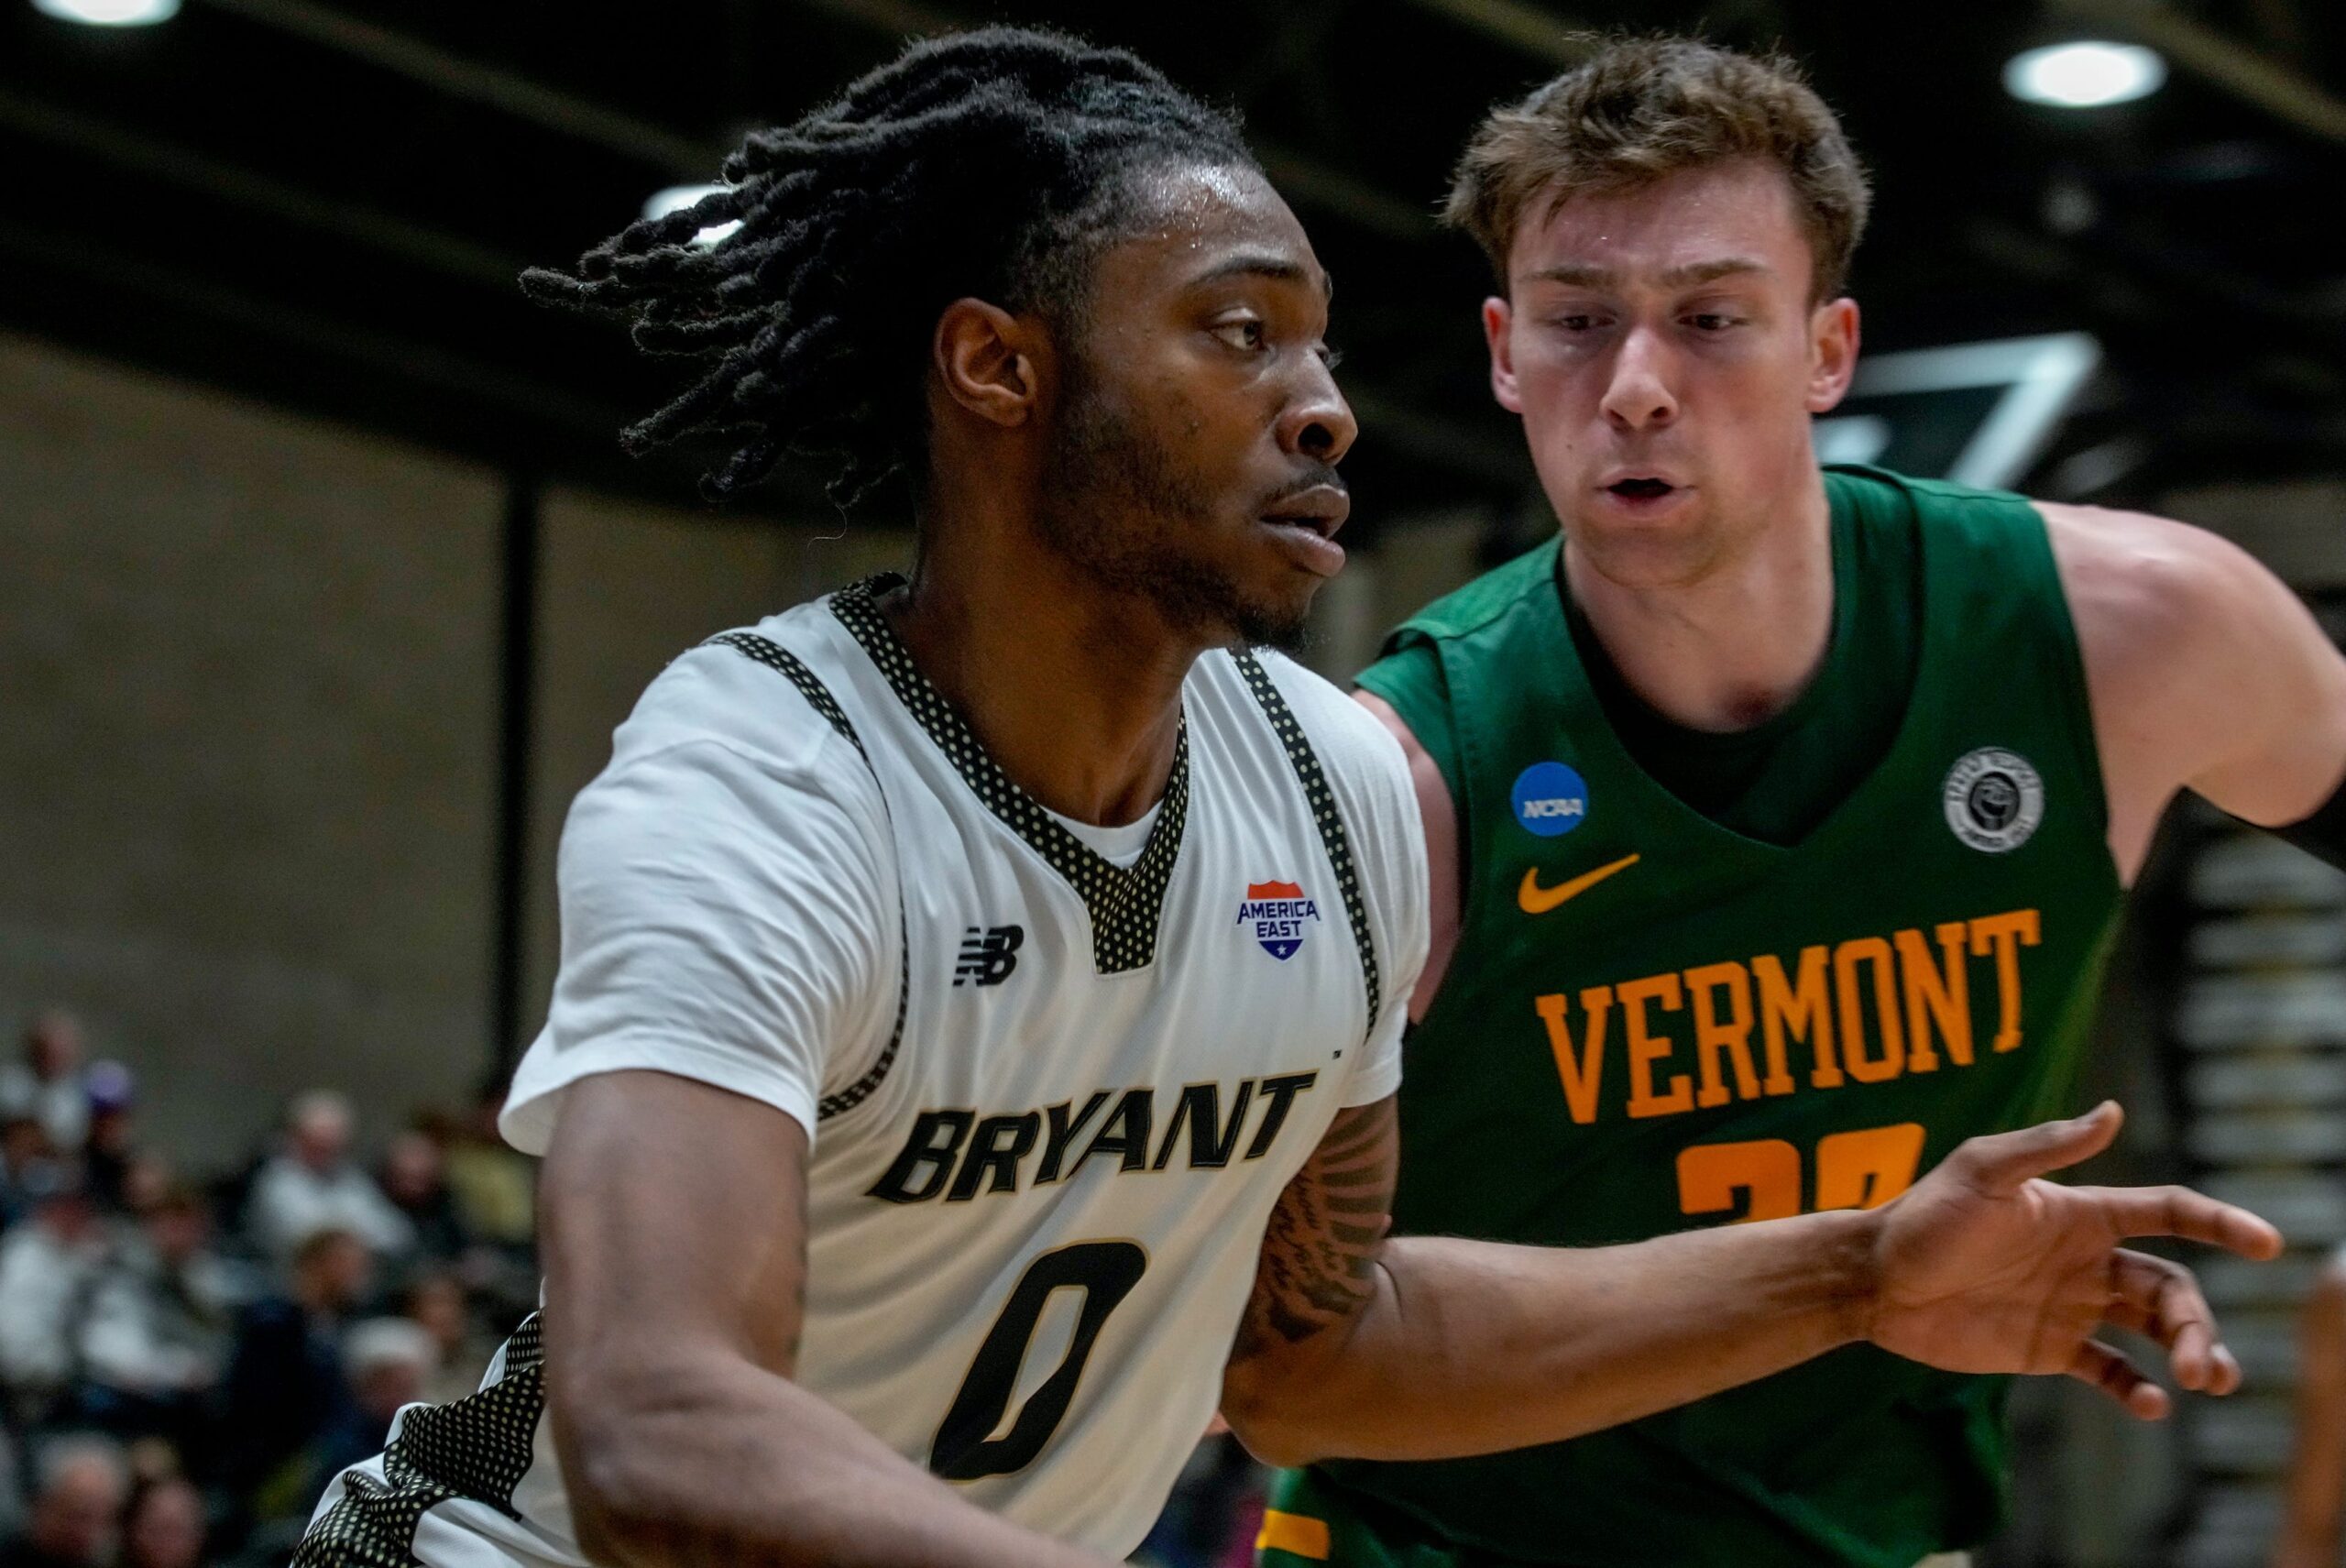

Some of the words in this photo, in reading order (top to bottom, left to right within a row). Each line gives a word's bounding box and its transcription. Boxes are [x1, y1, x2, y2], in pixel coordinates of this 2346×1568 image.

[1523, 798, 1584, 818] NCAA
[1236, 900, 1321, 925] AMERICA
[1256, 920, 1301, 938] EAST
[1535, 909, 2041, 1124] VERMONT
[864, 1069, 1320, 1206] BRYANT
[927, 1237, 1150, 1485] 0
